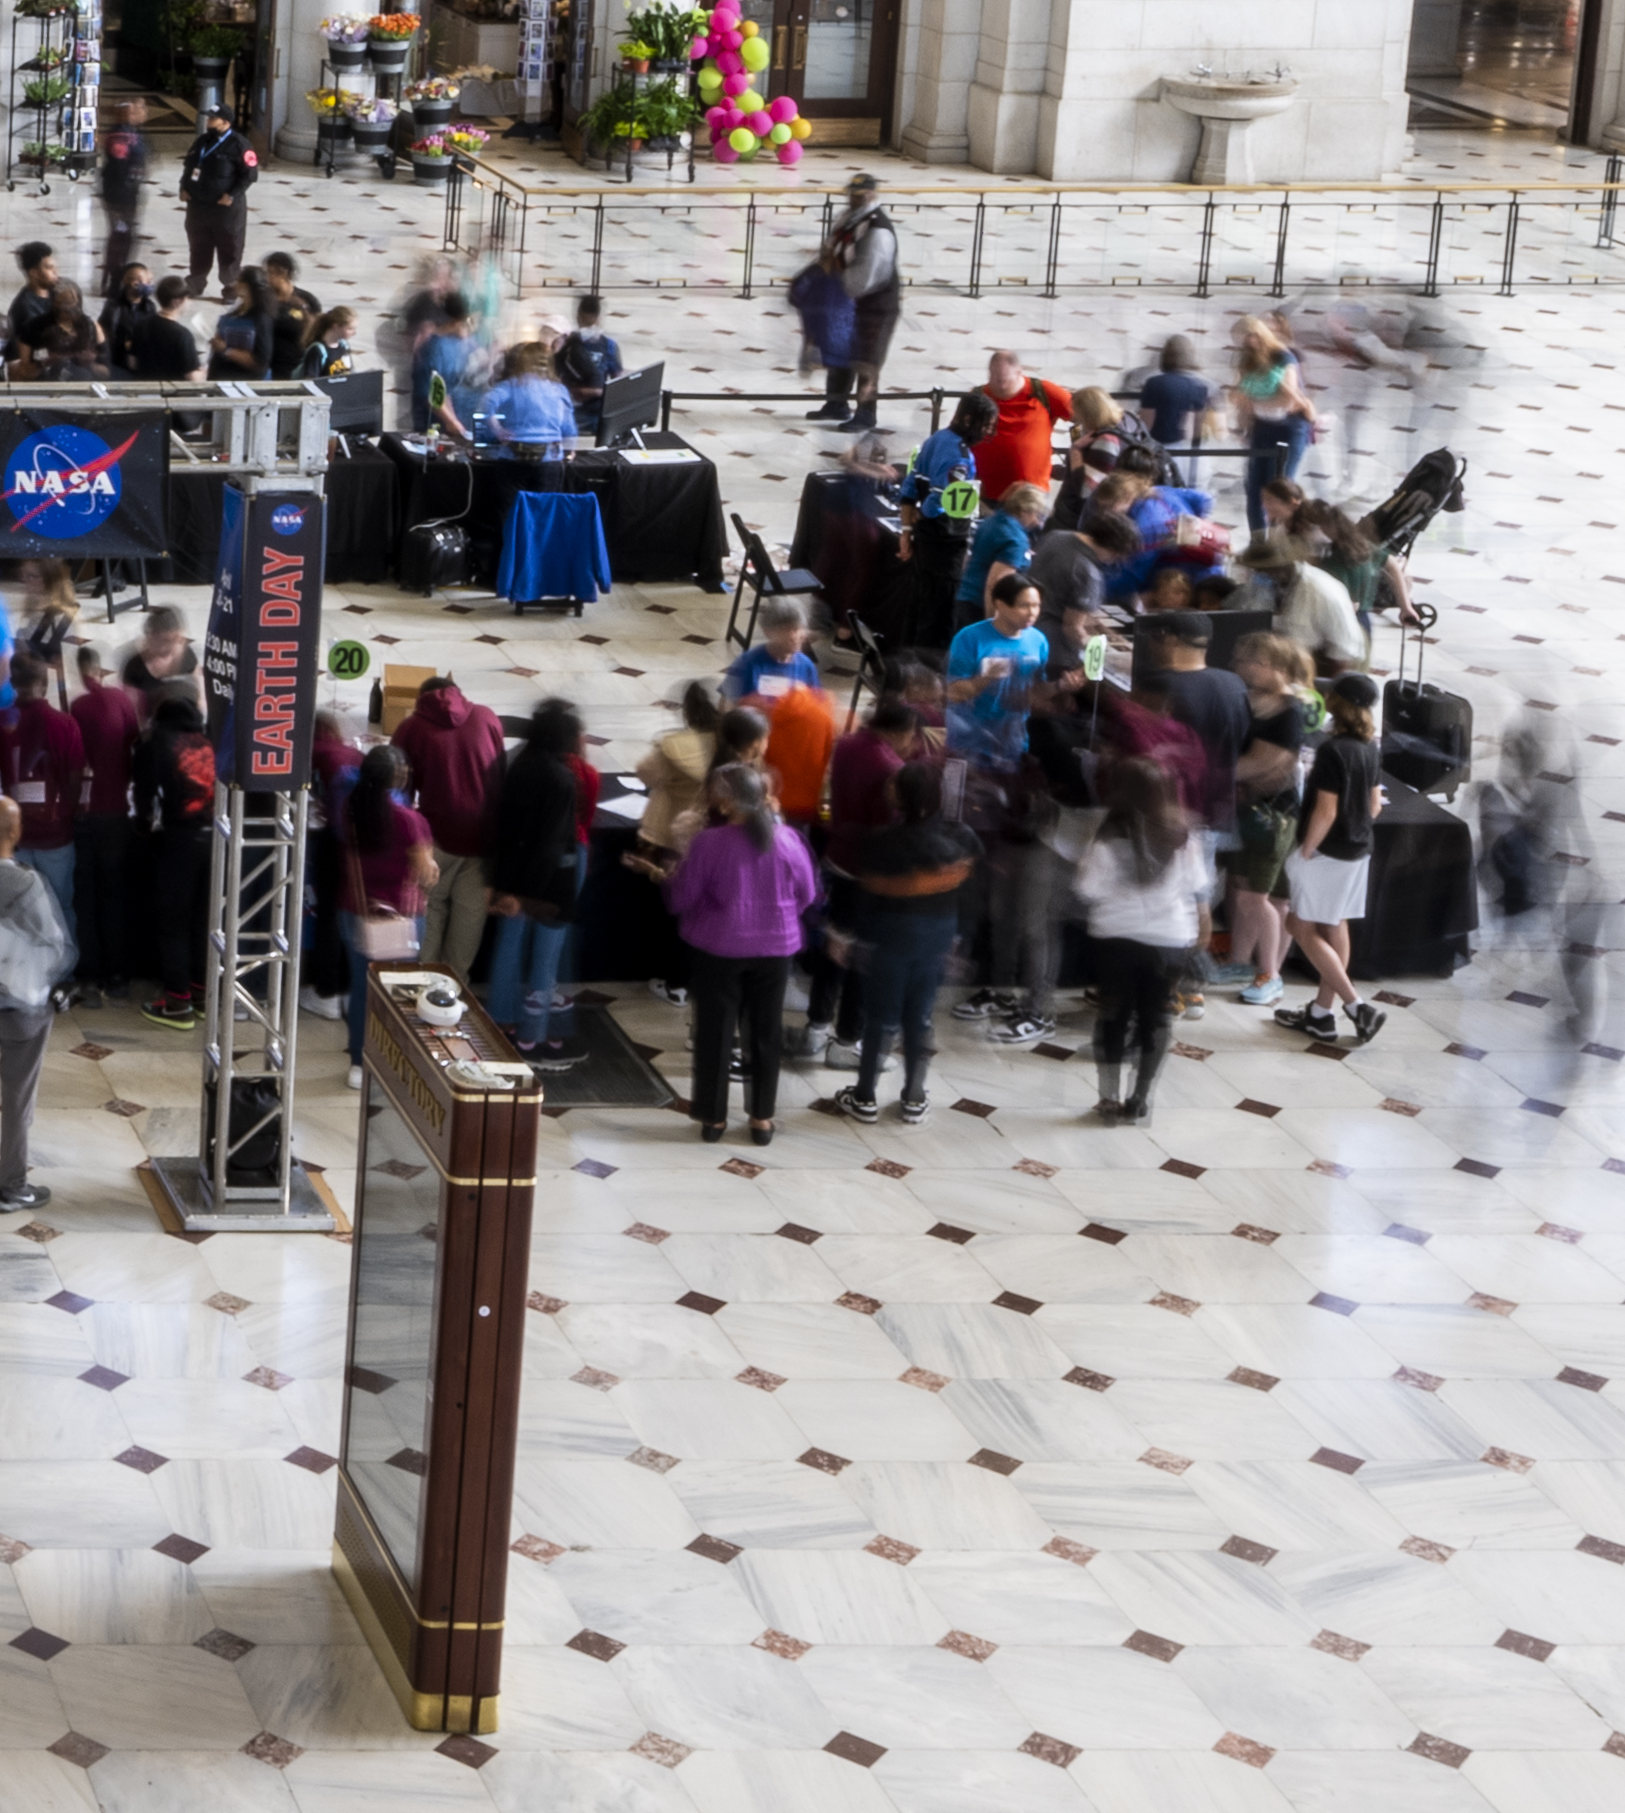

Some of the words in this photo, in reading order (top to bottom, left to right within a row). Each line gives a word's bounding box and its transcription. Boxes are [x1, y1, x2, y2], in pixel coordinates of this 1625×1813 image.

[946, 488, 974, 512] 17
[263, 545, 308, 628] DAY
[334, 648, 365, 672] 20
[1088, 645, 1102, 673] 19
[251, 637, 301, 777] EARTH
[369, 1011, 447, 1138] DIRECTORY
